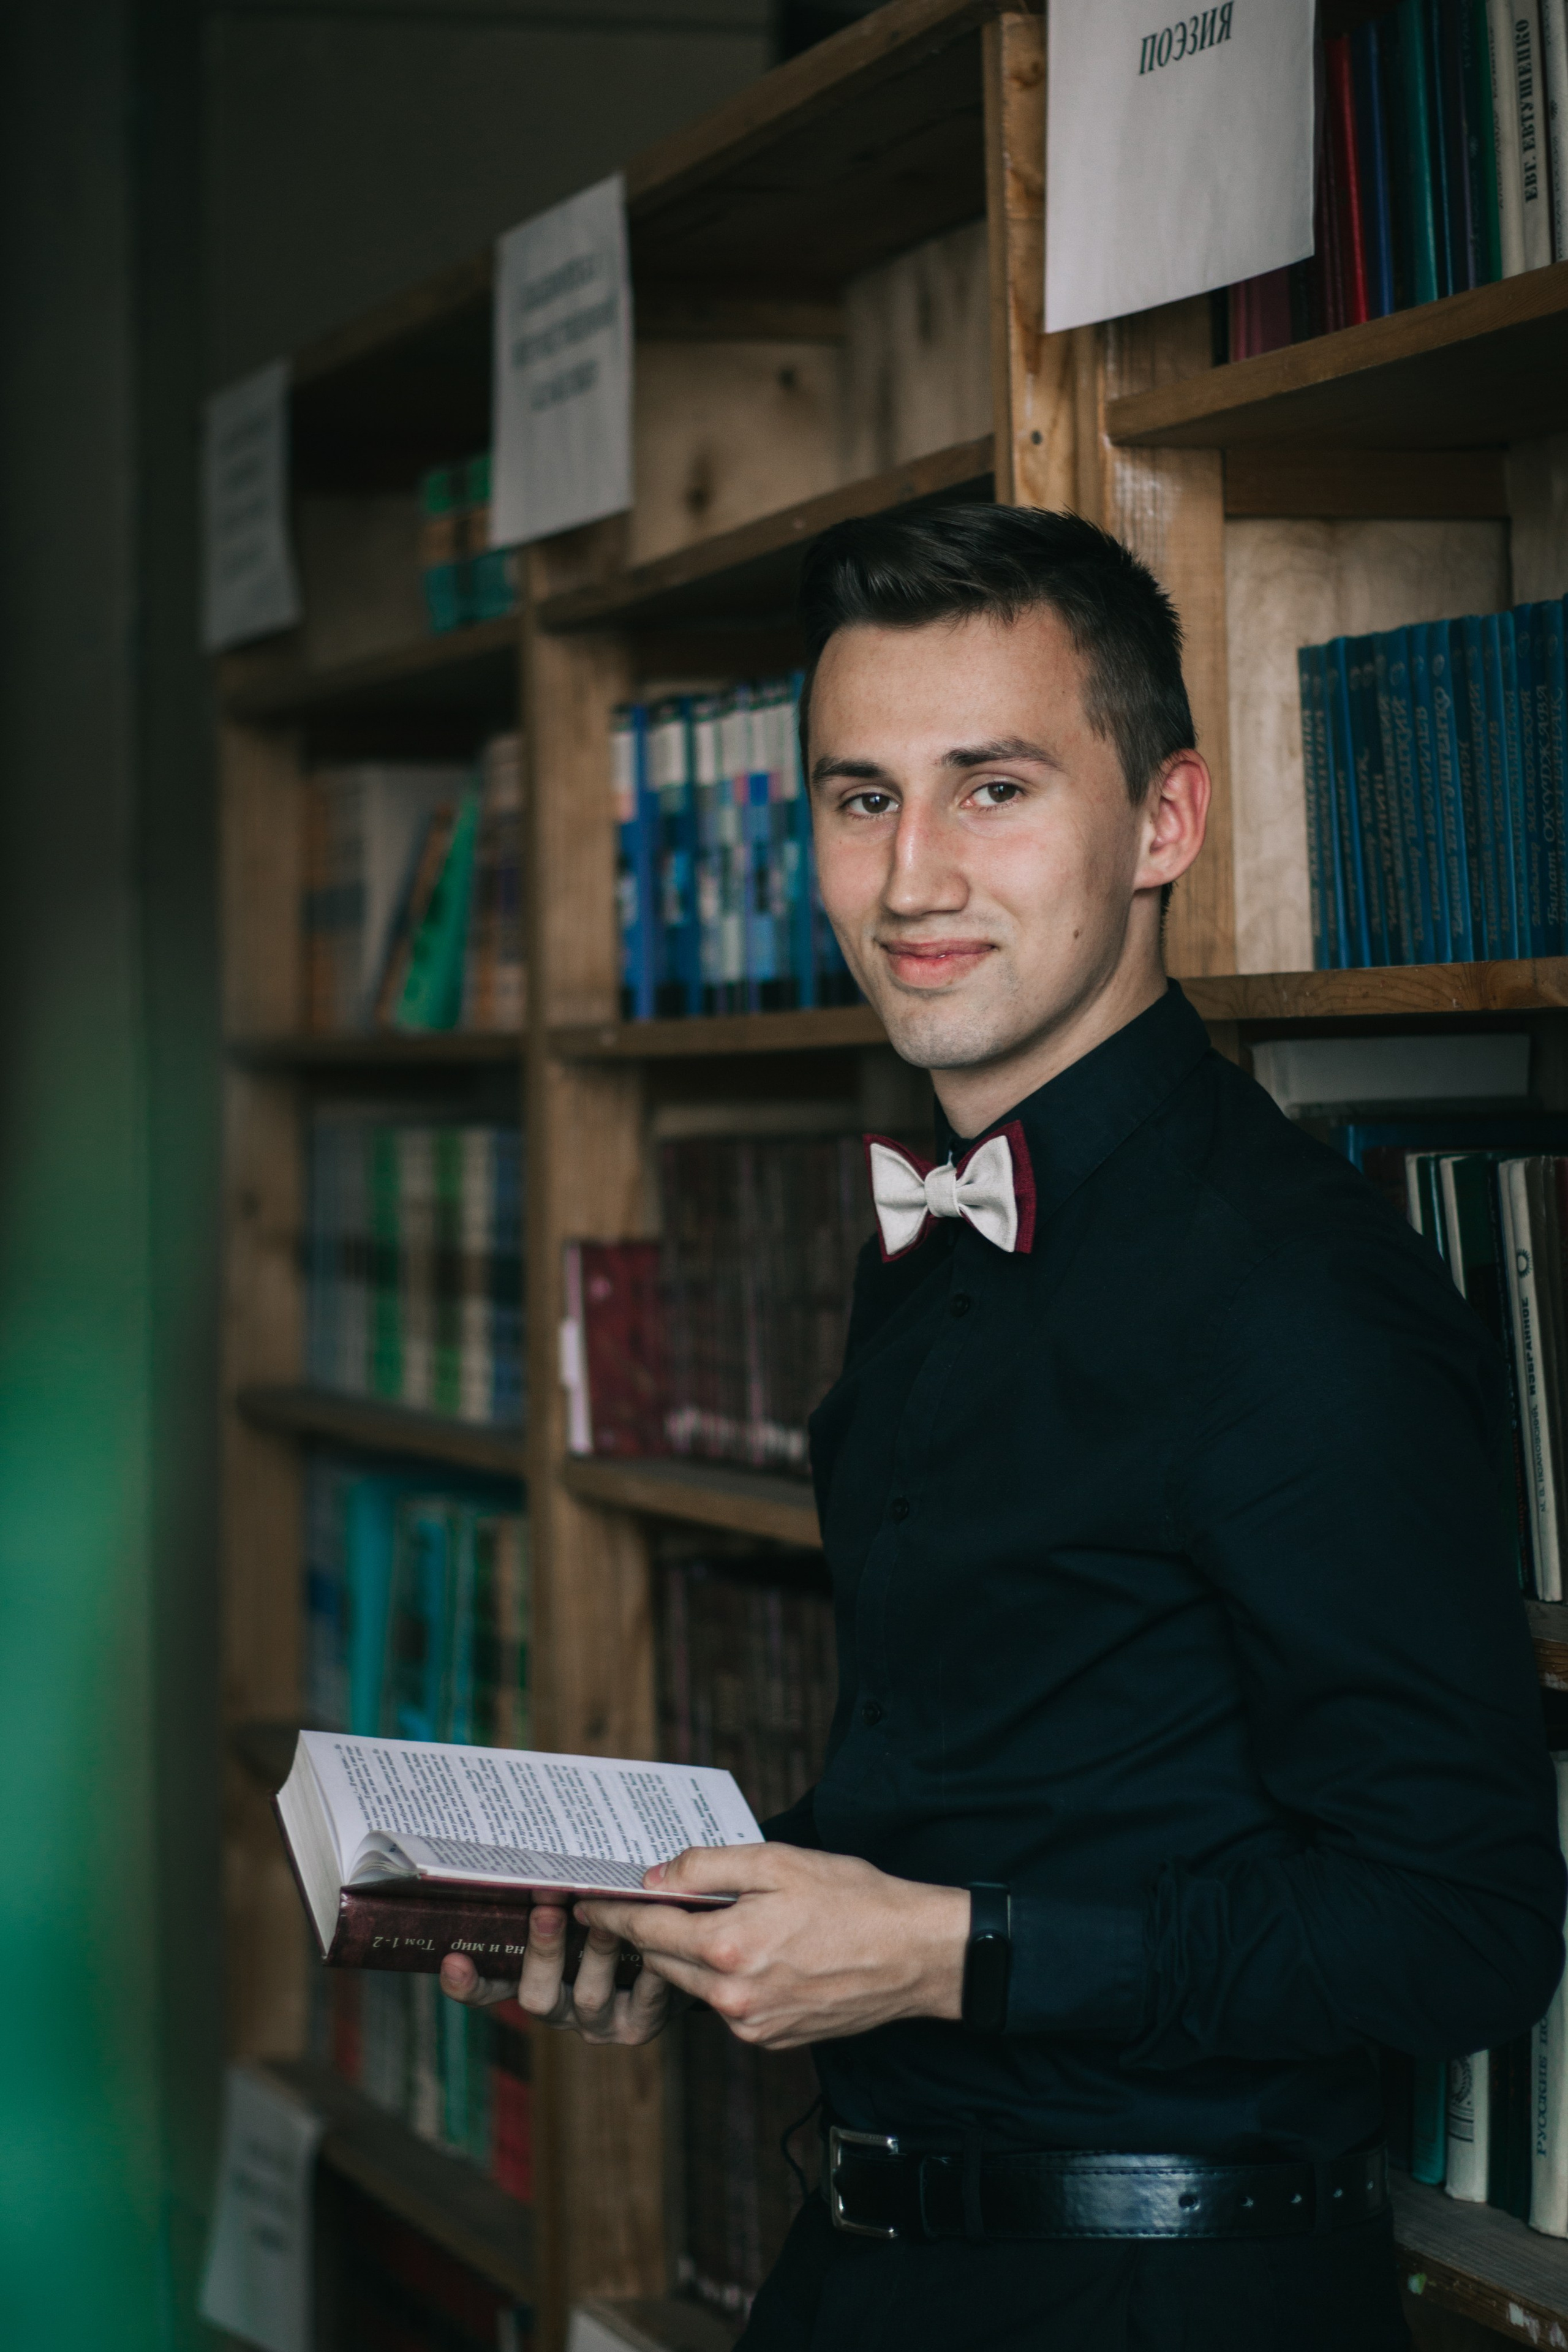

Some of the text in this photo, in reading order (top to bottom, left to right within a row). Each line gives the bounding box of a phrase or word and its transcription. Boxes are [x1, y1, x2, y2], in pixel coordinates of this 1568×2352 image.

[1139, 1, 1234, 75] ПОЭЗИЯ
[1515, 19, 1538, 203] ЕВГ. ЕВТУШЕНКО
[1534, 682, 1556, 843] ОКУДЖАВА
[1520, 1297, 1537, 1396] ИЗБРАННОЕ
[372, 1936, 400, 1948] 1-2
[404, 1937, 435, 1951] Том
[450, 1939, 486, 1952] мир
[489, 1943, 500, 1953] и
